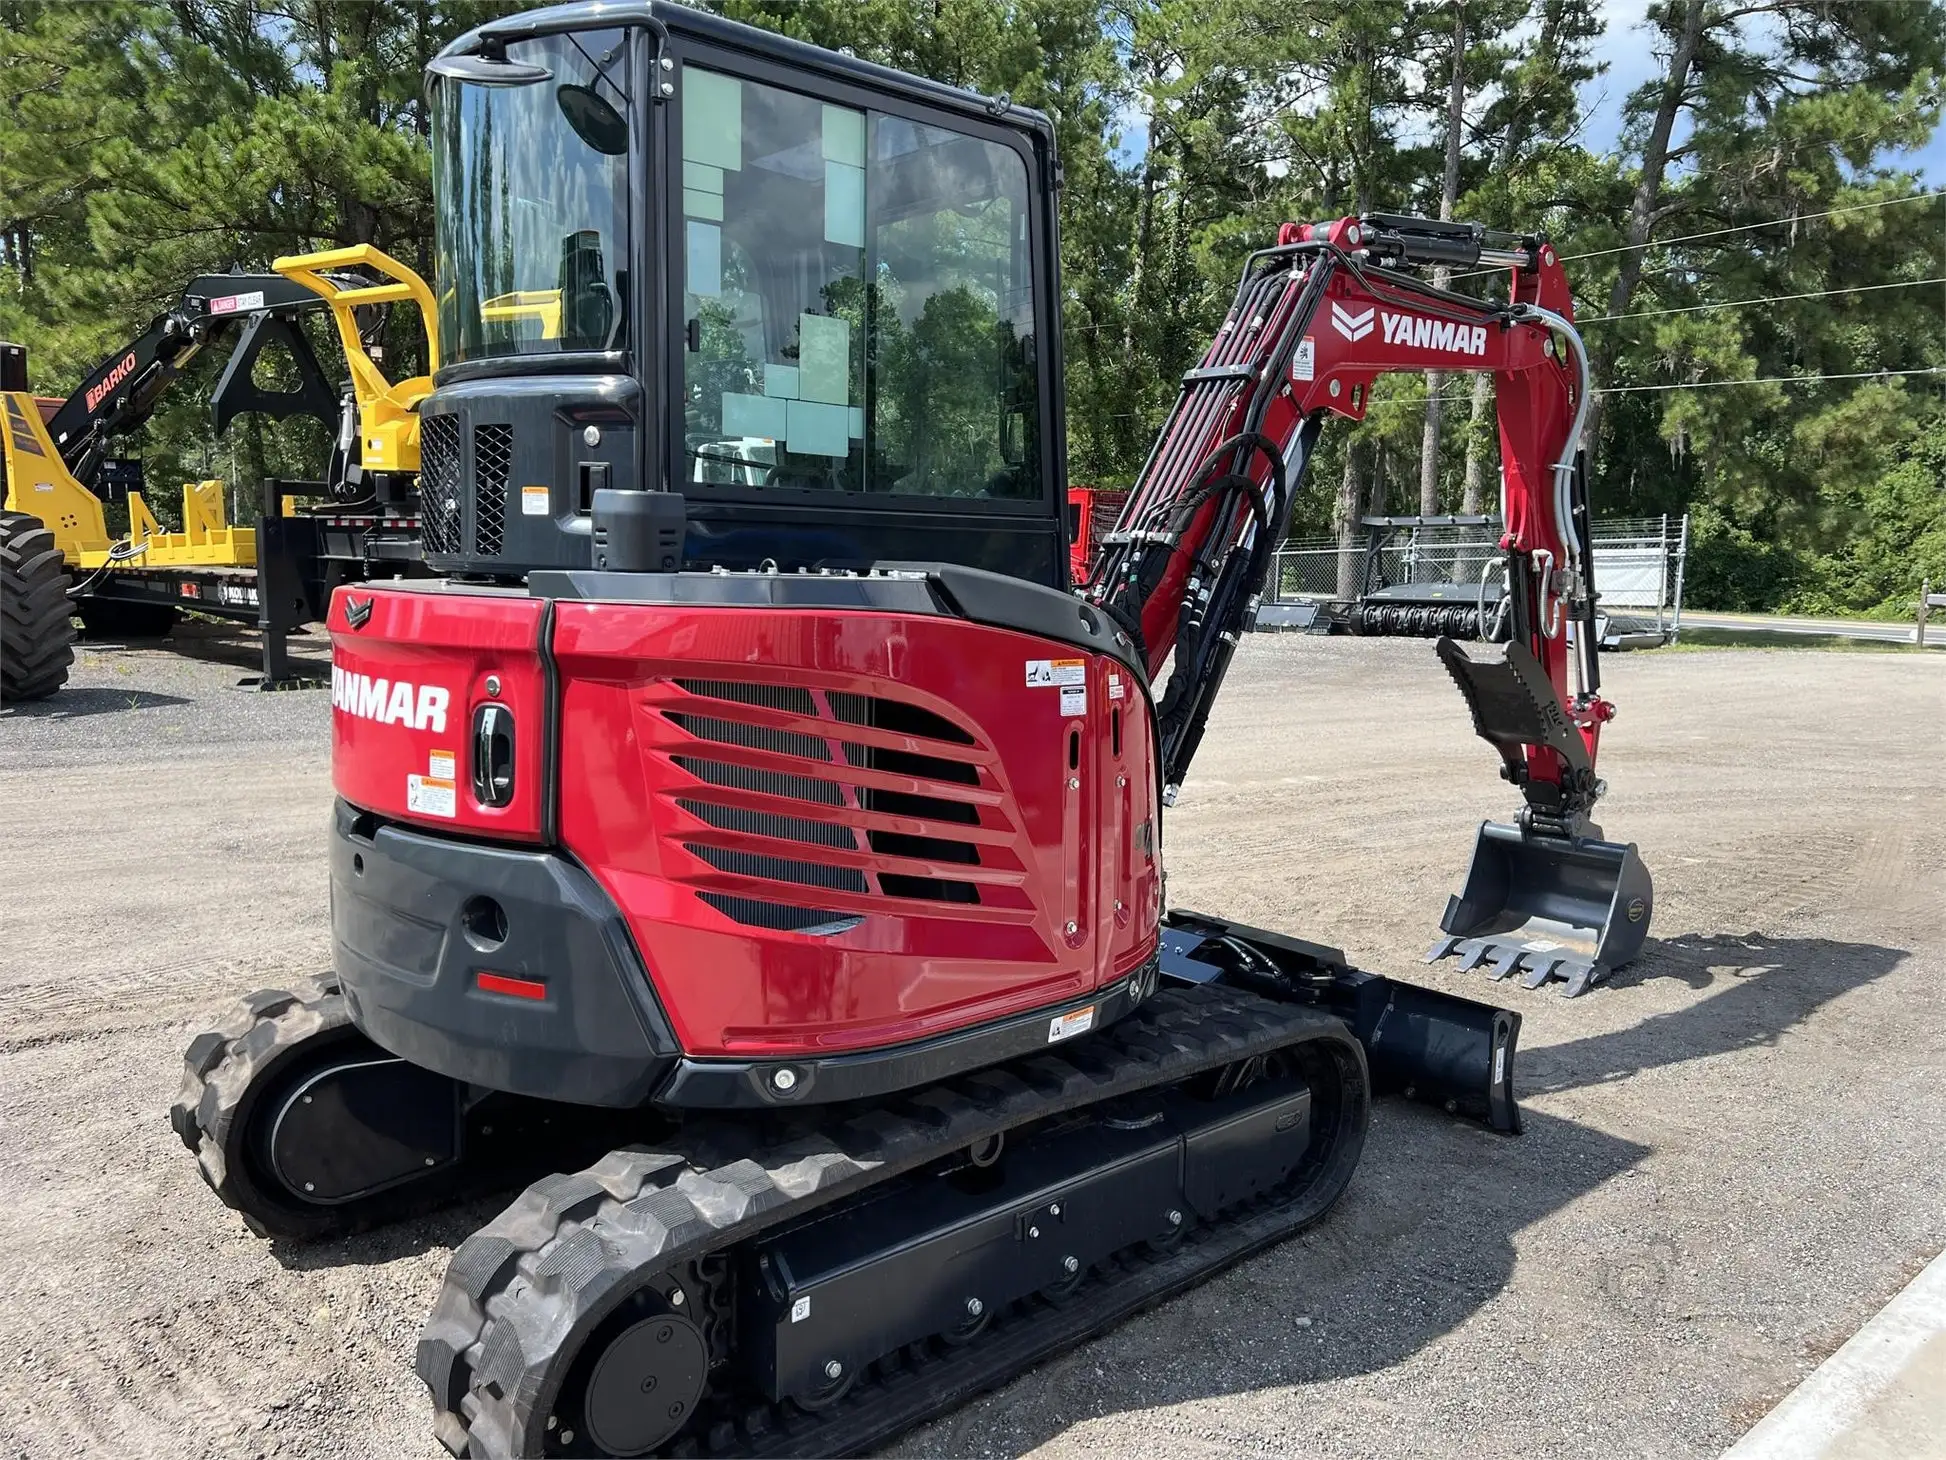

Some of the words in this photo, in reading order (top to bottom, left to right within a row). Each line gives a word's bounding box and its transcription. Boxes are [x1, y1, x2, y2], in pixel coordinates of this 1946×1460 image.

[1381, 312, 1487, 356] YANMAR
[93, 352, 136, 404] BARKO
[228, 586, 258, 601] KODIAK
